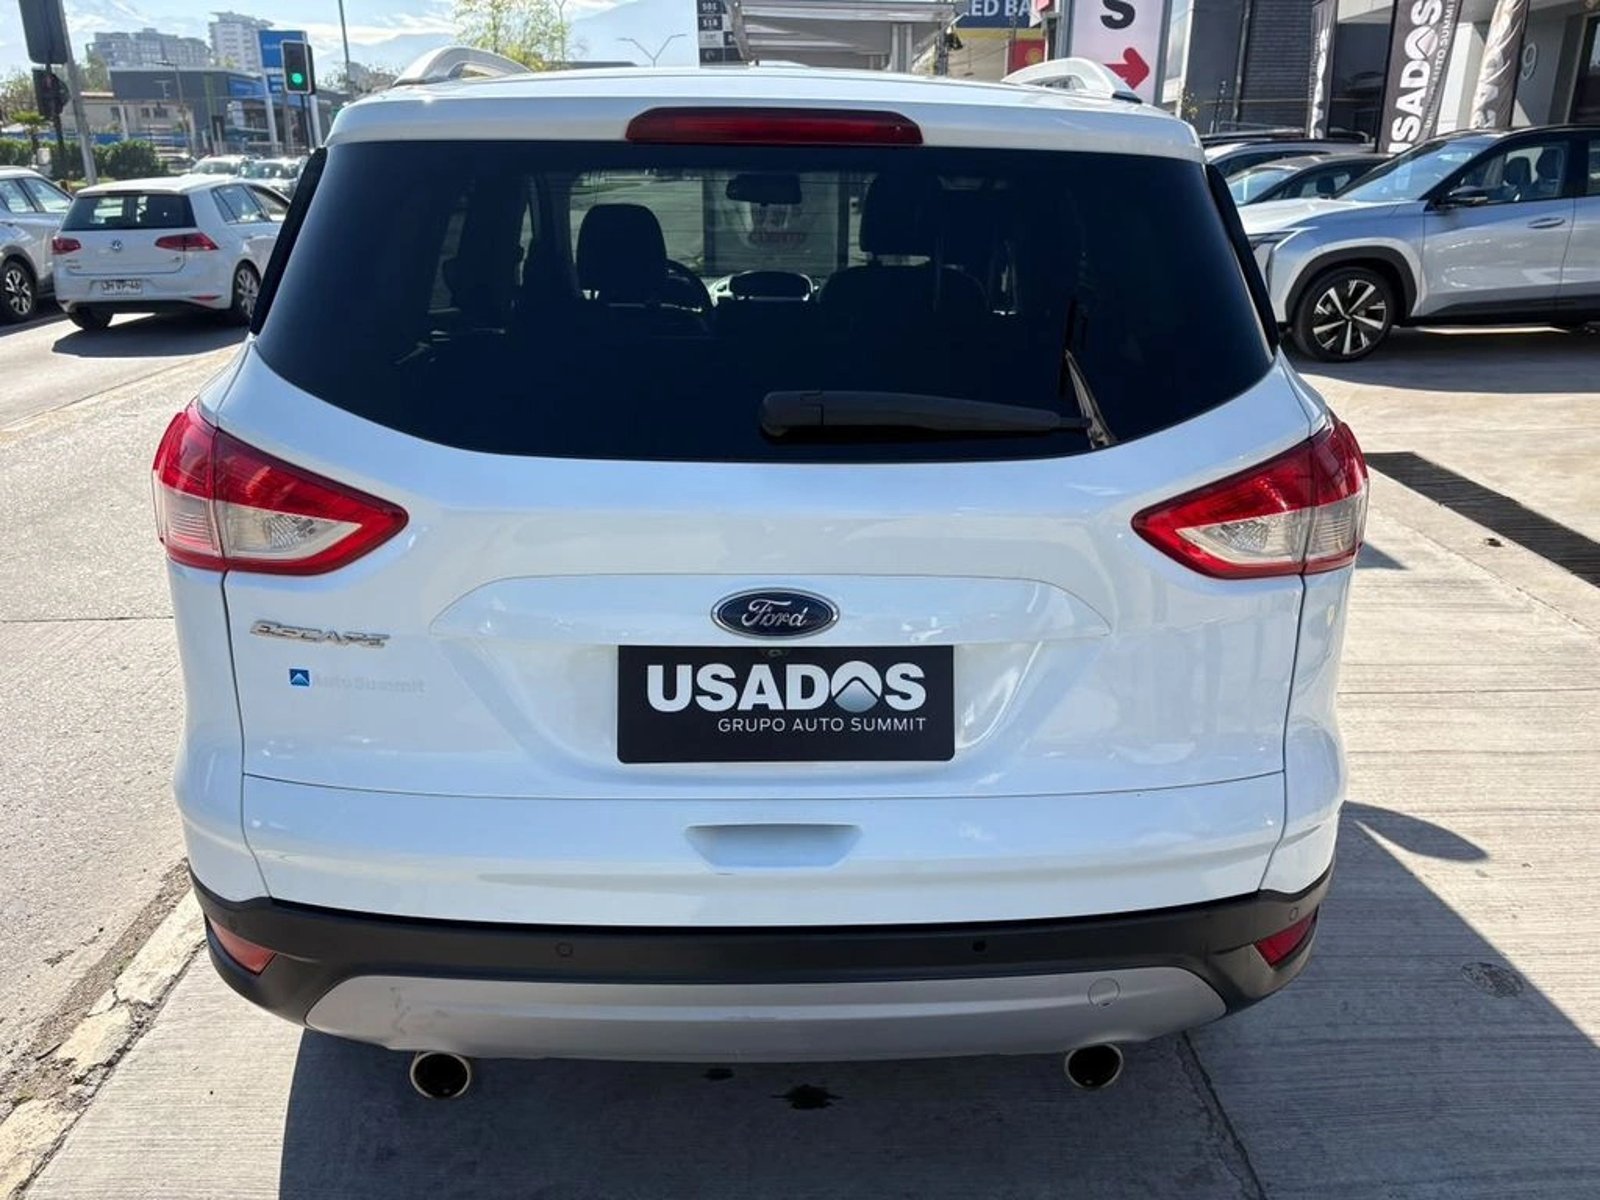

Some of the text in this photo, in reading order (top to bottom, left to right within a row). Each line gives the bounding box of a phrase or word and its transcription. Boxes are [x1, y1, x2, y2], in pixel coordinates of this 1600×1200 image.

[741, 598, 808, 628] Ford
[250, 619, 391, 648] ESCAPE
[647, 660, 927, 713] USADOS
[718, 718, 927, 733] GRUPO AUTO SUMMIT
